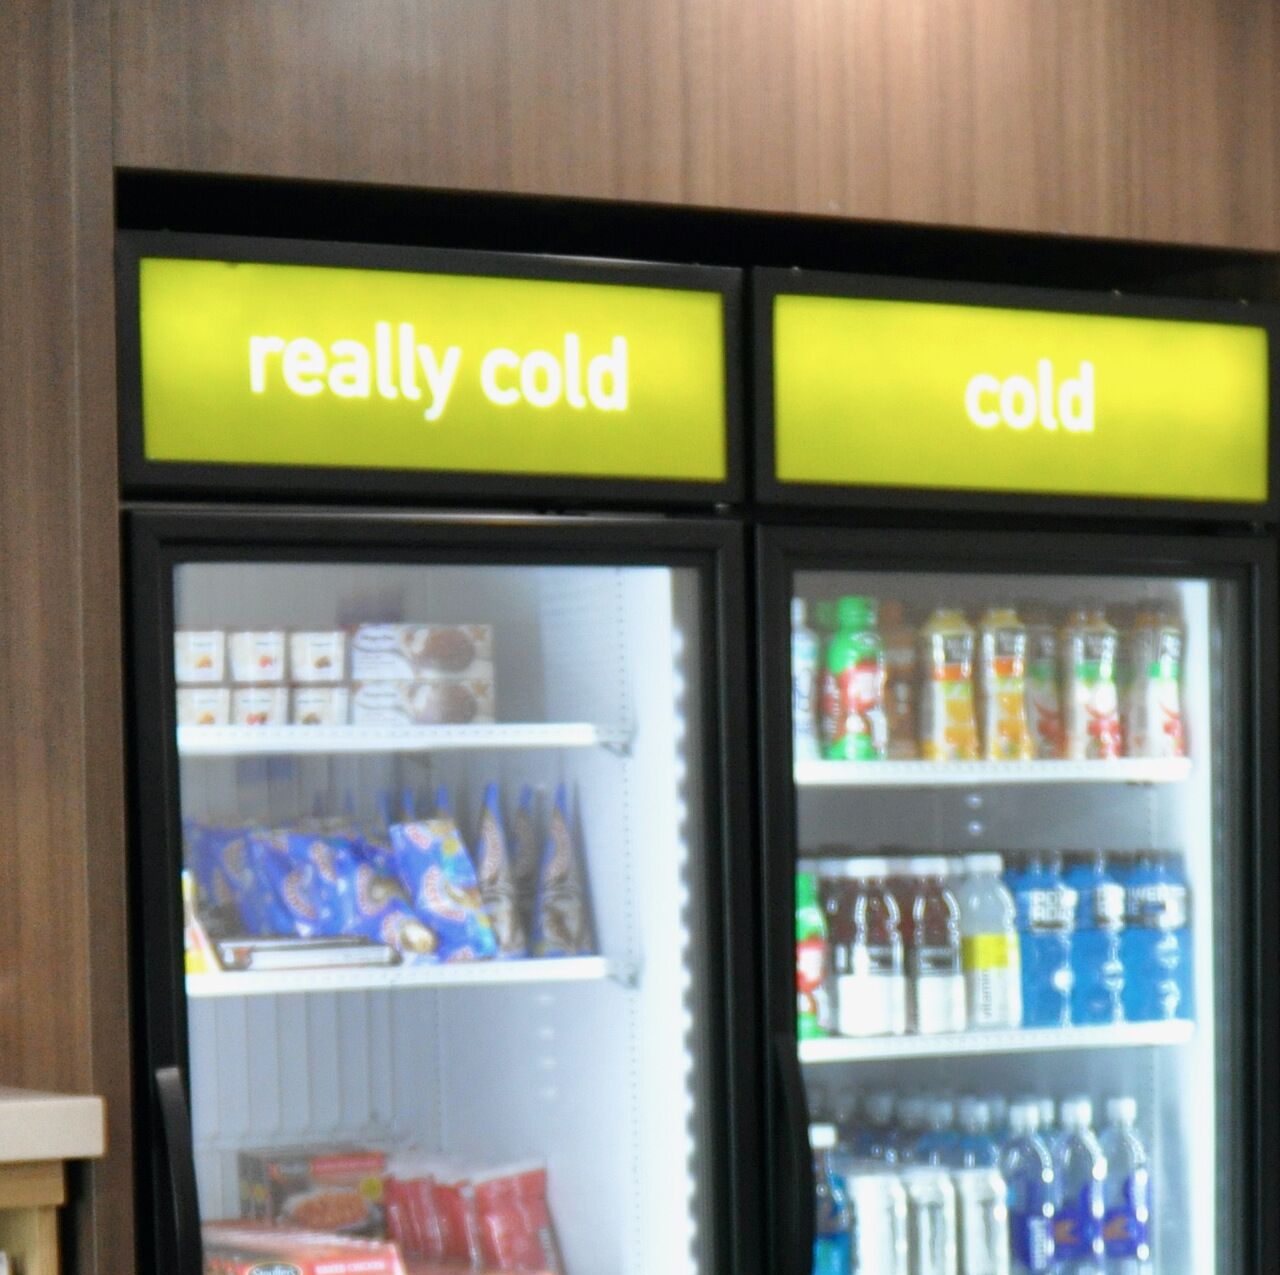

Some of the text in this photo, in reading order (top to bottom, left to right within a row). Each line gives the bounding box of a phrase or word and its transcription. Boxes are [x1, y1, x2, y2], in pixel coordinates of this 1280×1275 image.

[248, 322, 630, 420] really cold
[964, 361, 1096, 433] cold
